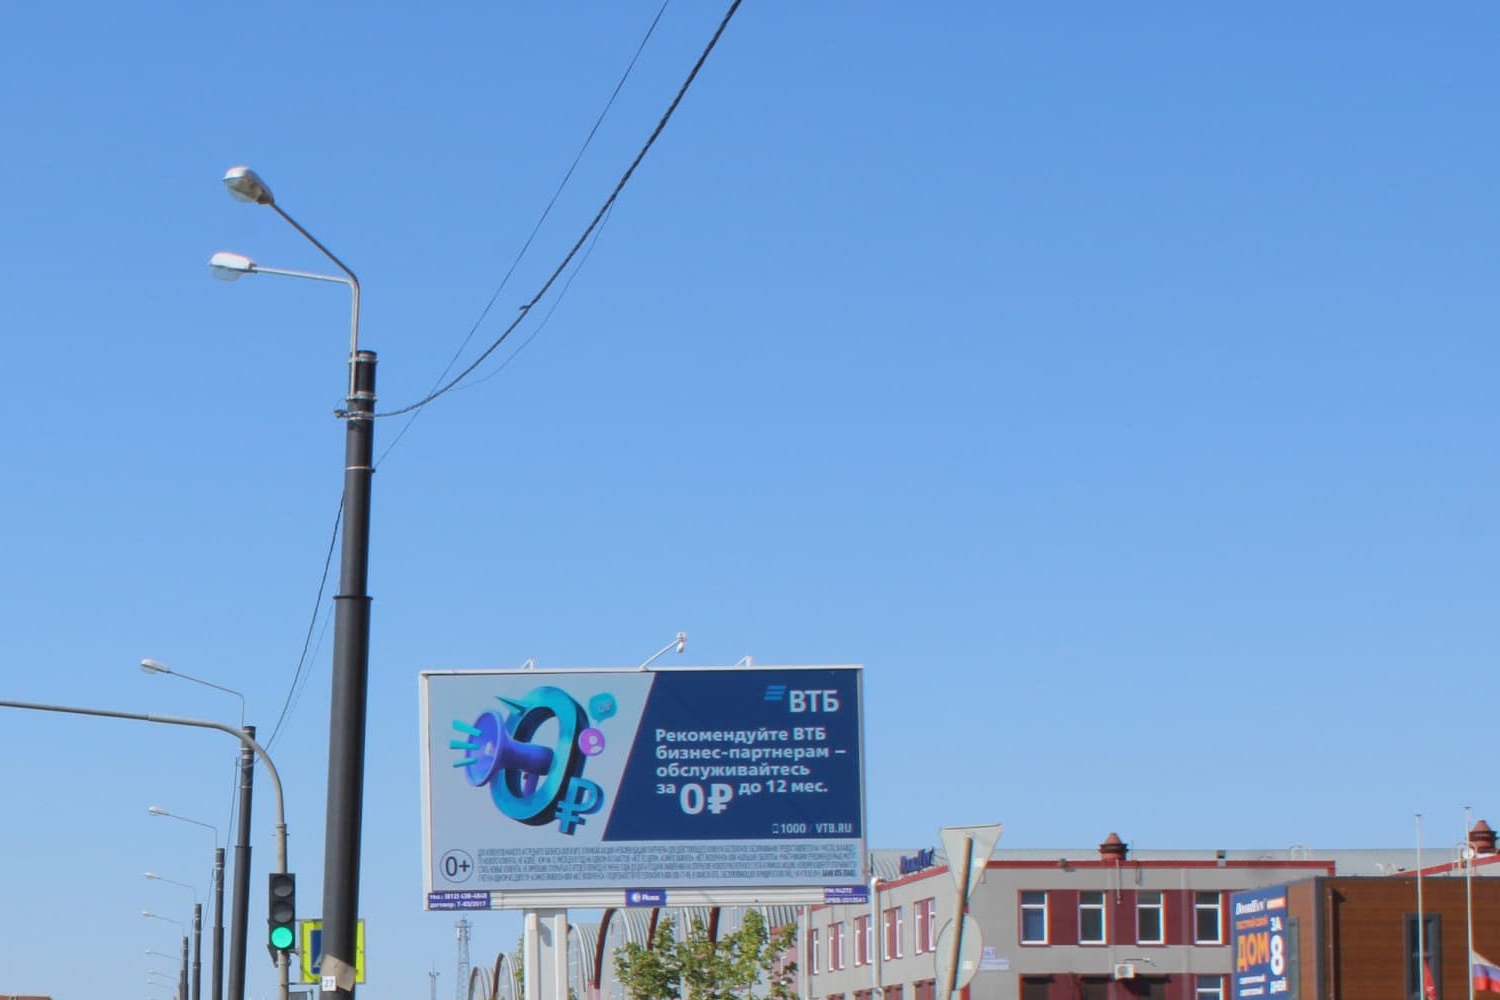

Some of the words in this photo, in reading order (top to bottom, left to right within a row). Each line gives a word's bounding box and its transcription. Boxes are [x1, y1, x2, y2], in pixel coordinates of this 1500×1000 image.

[789, 689, 840, 713] ВТБ
[655, 728, 789, 744] Рекомендуйте
[793, 727, 827, 741] ВТБ
[655, 745, 830, 762] бизнес-партнерам
[656, 762, 811, 780] обслуживайтесь
[656, 783, 677, 795] за
[738, 782, 762, 796] до
[766, 780, 788, 793] 12
[791, 781, 829, 793] мес.
[780, 823, 807, 834] 1000
[815, 823, 853, 834] VTB.RU
[445, 856, 471, 877] 0+
[1237, 932, 1270, 973] ДОМ
[1270, 934, 1285, 976] 8
